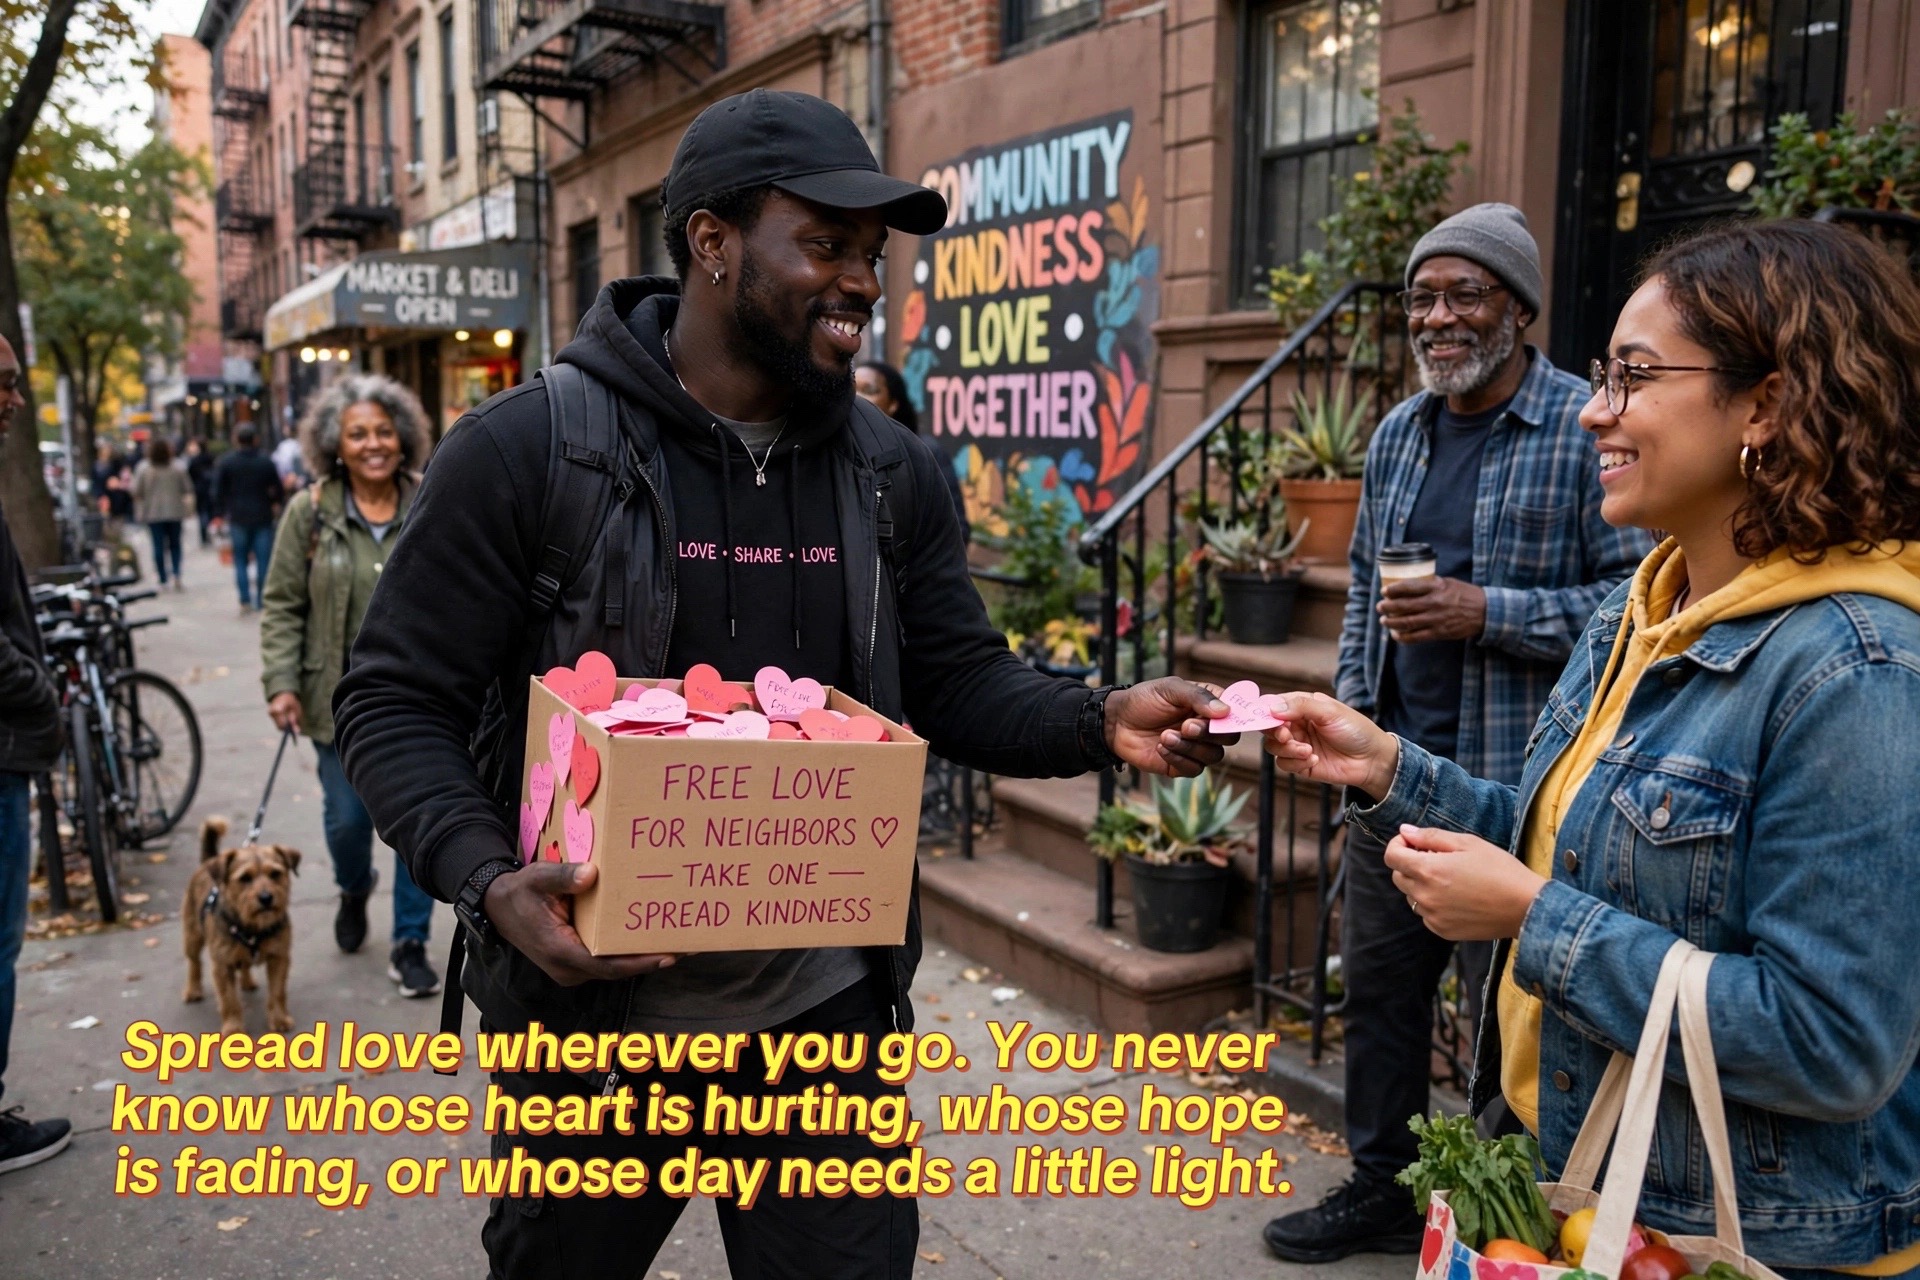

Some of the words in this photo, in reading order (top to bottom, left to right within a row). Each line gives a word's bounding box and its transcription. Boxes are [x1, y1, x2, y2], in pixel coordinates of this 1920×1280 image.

[934, 210, 1104, 301] KINDNESS
[346, 261, 440, 295] MARKET
[445, 266, 465, 296] &
[469, 266, 518, 298] DELI
[395, 297, 457, 324] OPEN
[960, 295, 1051, 368] LOVE
[927, 370, 1098, 438] TOGETHER
[678, 541, 717, 560] LOVE
[734, 546, 783, 563] SHARE
[802, 547, 838, 563] LOVE
[663, 763, 752, 801] FREE
[772, 766, 855, 800] LOVE
[631, 816, 686, 849] FOR
[705, 817, 857, 847] NEIGHBORS
[682, 862, 751, 888] TAKE
[768, 862, 819, 886] ONE
[625, 900, 730, 931] SPREAD
[746, 897, 871, 926] KINDNESS
